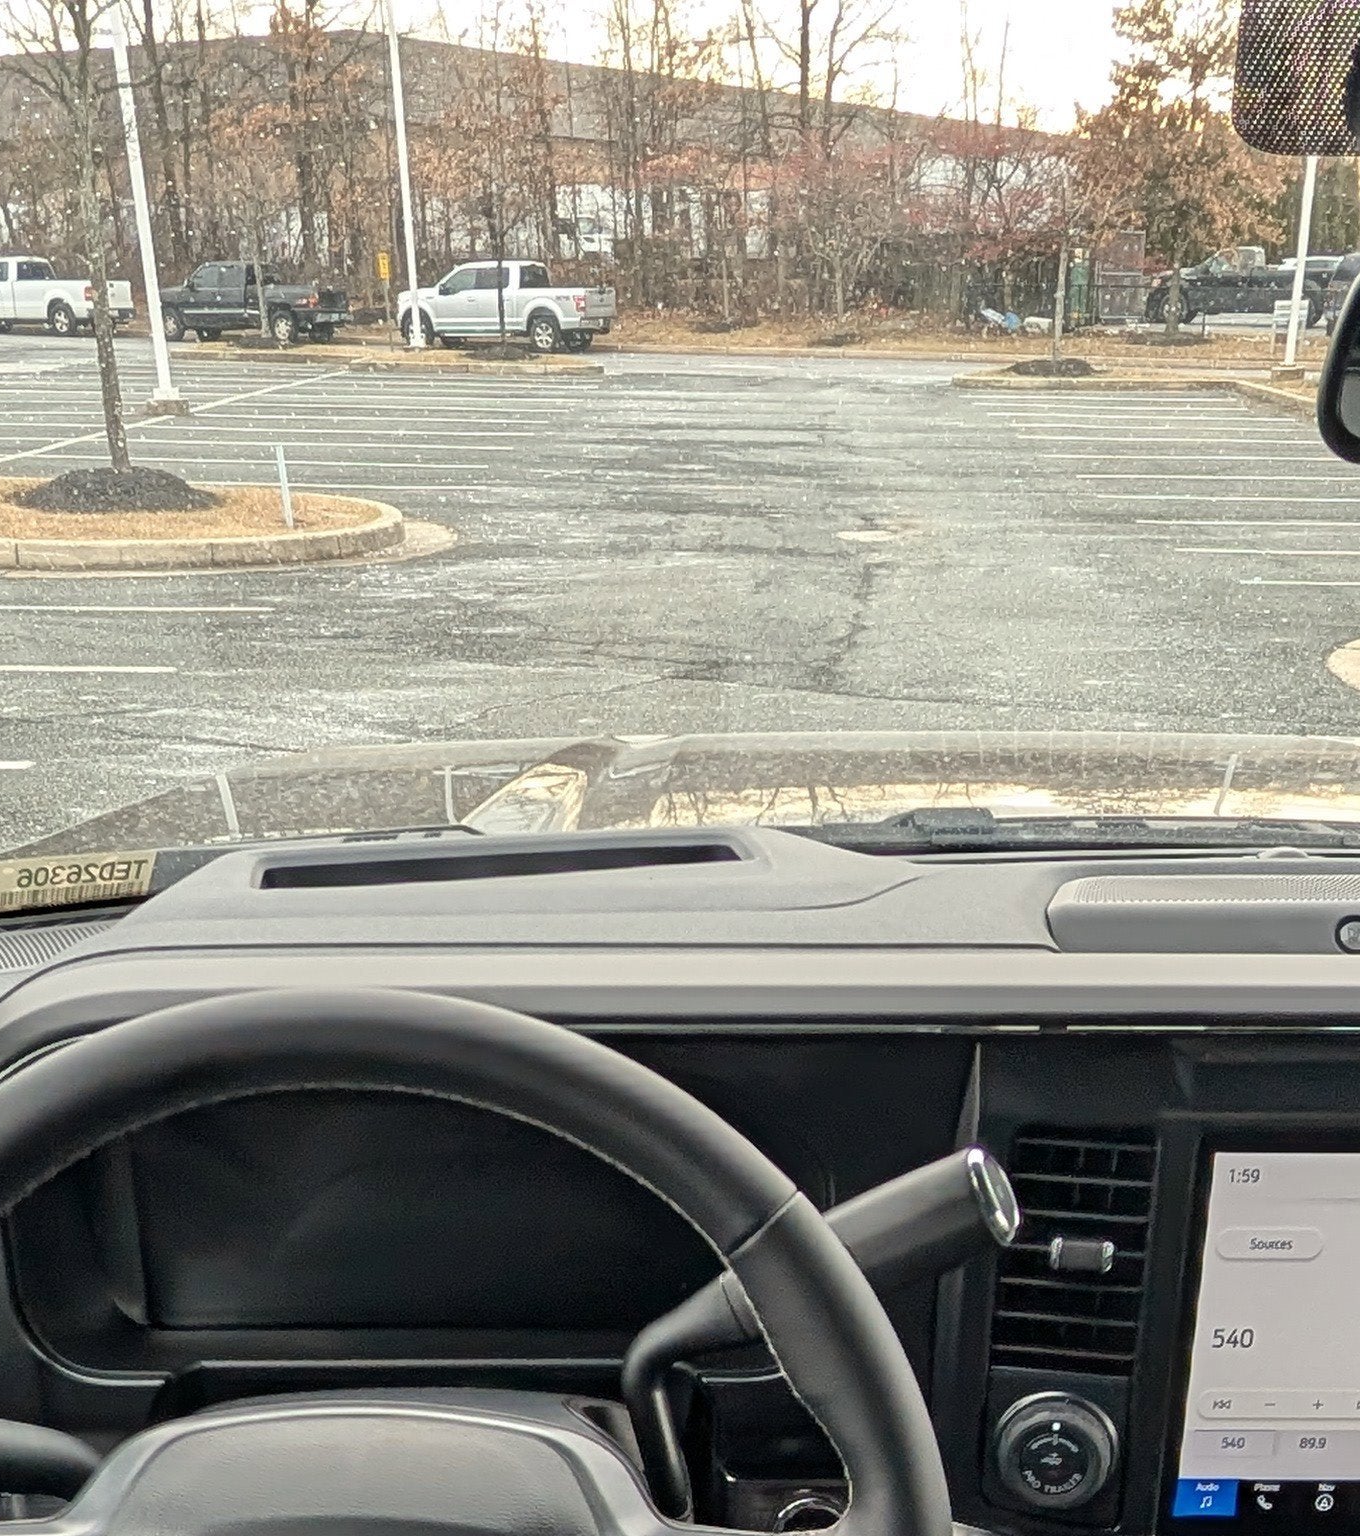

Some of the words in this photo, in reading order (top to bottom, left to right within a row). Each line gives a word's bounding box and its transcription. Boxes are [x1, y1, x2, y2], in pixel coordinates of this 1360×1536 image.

[1228, 1168, 1261, 1184] 1:59
[1248, 1237, 1293, 1251] Sources
[1211, 1327, 1255, 1349] 540
[1220, 1436, 1246, 1450] 540
[1298, 1436, 1328, 1450] 89.9
[1022, 1470, 1041, 1489] PRO
[1044, 1473, 1083, 1493] TRAILER
[1195, 1482, 1220, 1492] Audio
[1253, 1482, 1281, 1493] Phone
[1317, 1482, 1337, 1493] Nav
